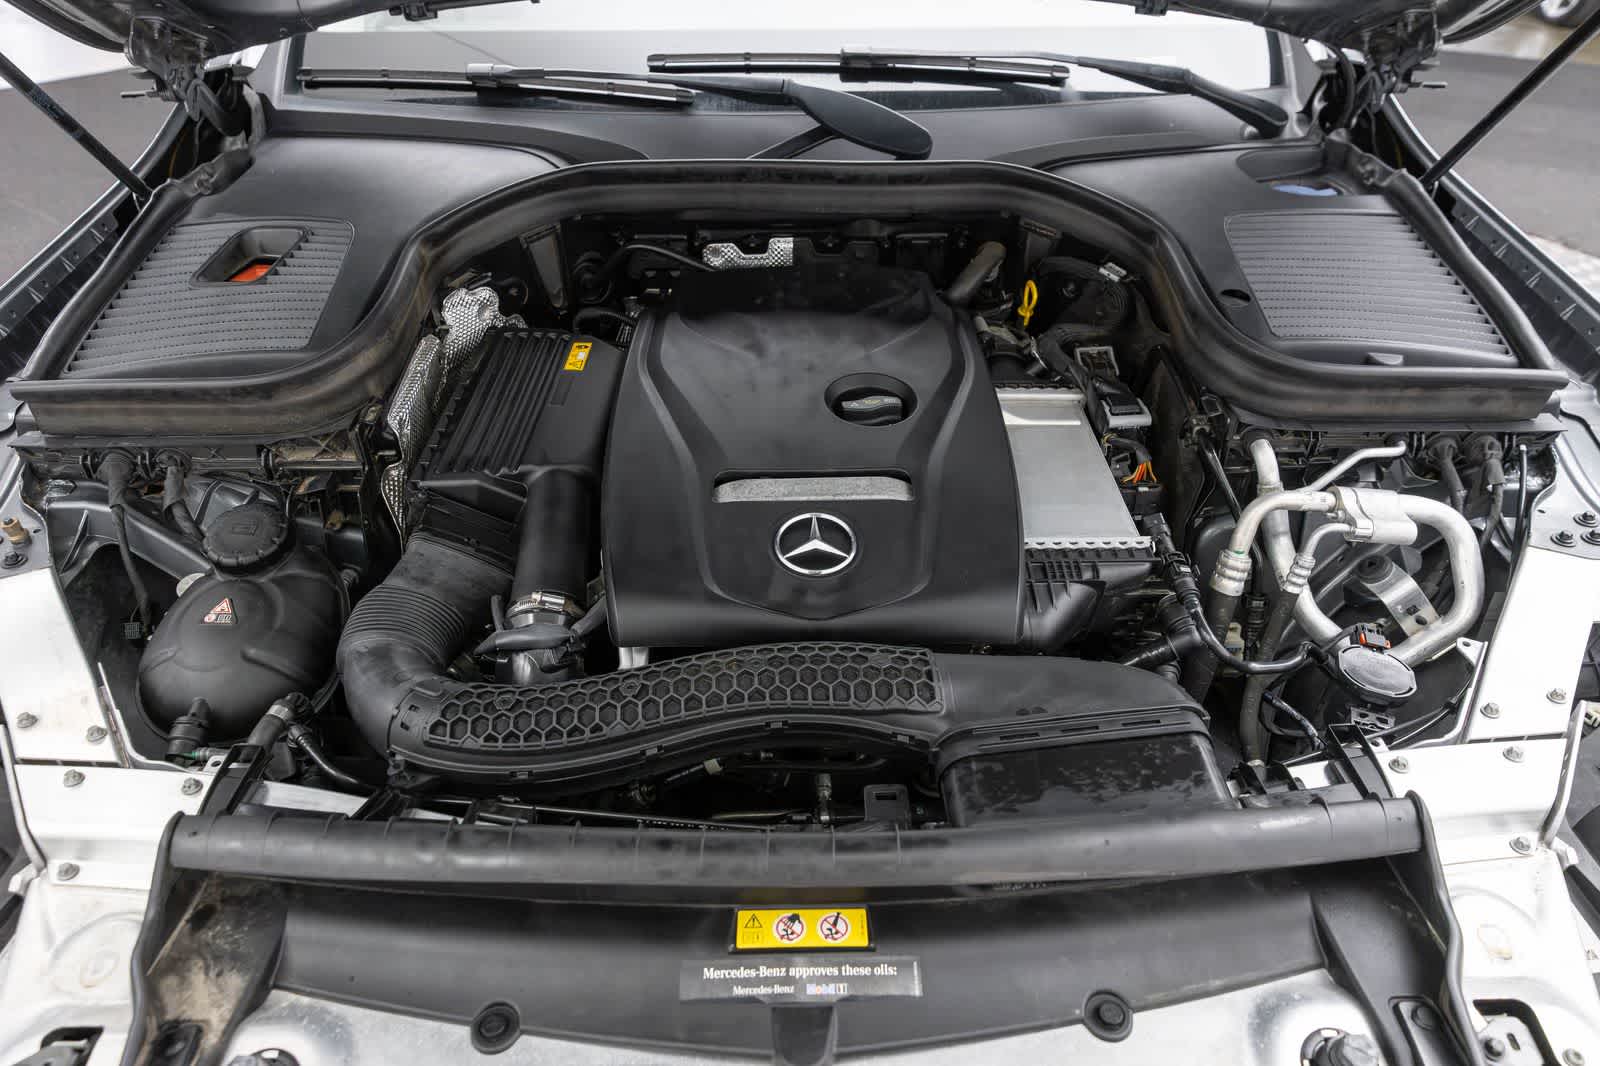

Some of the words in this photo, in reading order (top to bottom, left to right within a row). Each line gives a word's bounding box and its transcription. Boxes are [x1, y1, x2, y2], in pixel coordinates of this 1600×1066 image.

[702, 965, 786, 980] Mercedes-Benz
[788, 966, 839, 979] approves
[841, 964, 871, 976] these
[873, 963, 897, 976] oils:
[732, 984, 795, 996] Mercedes-Benz
